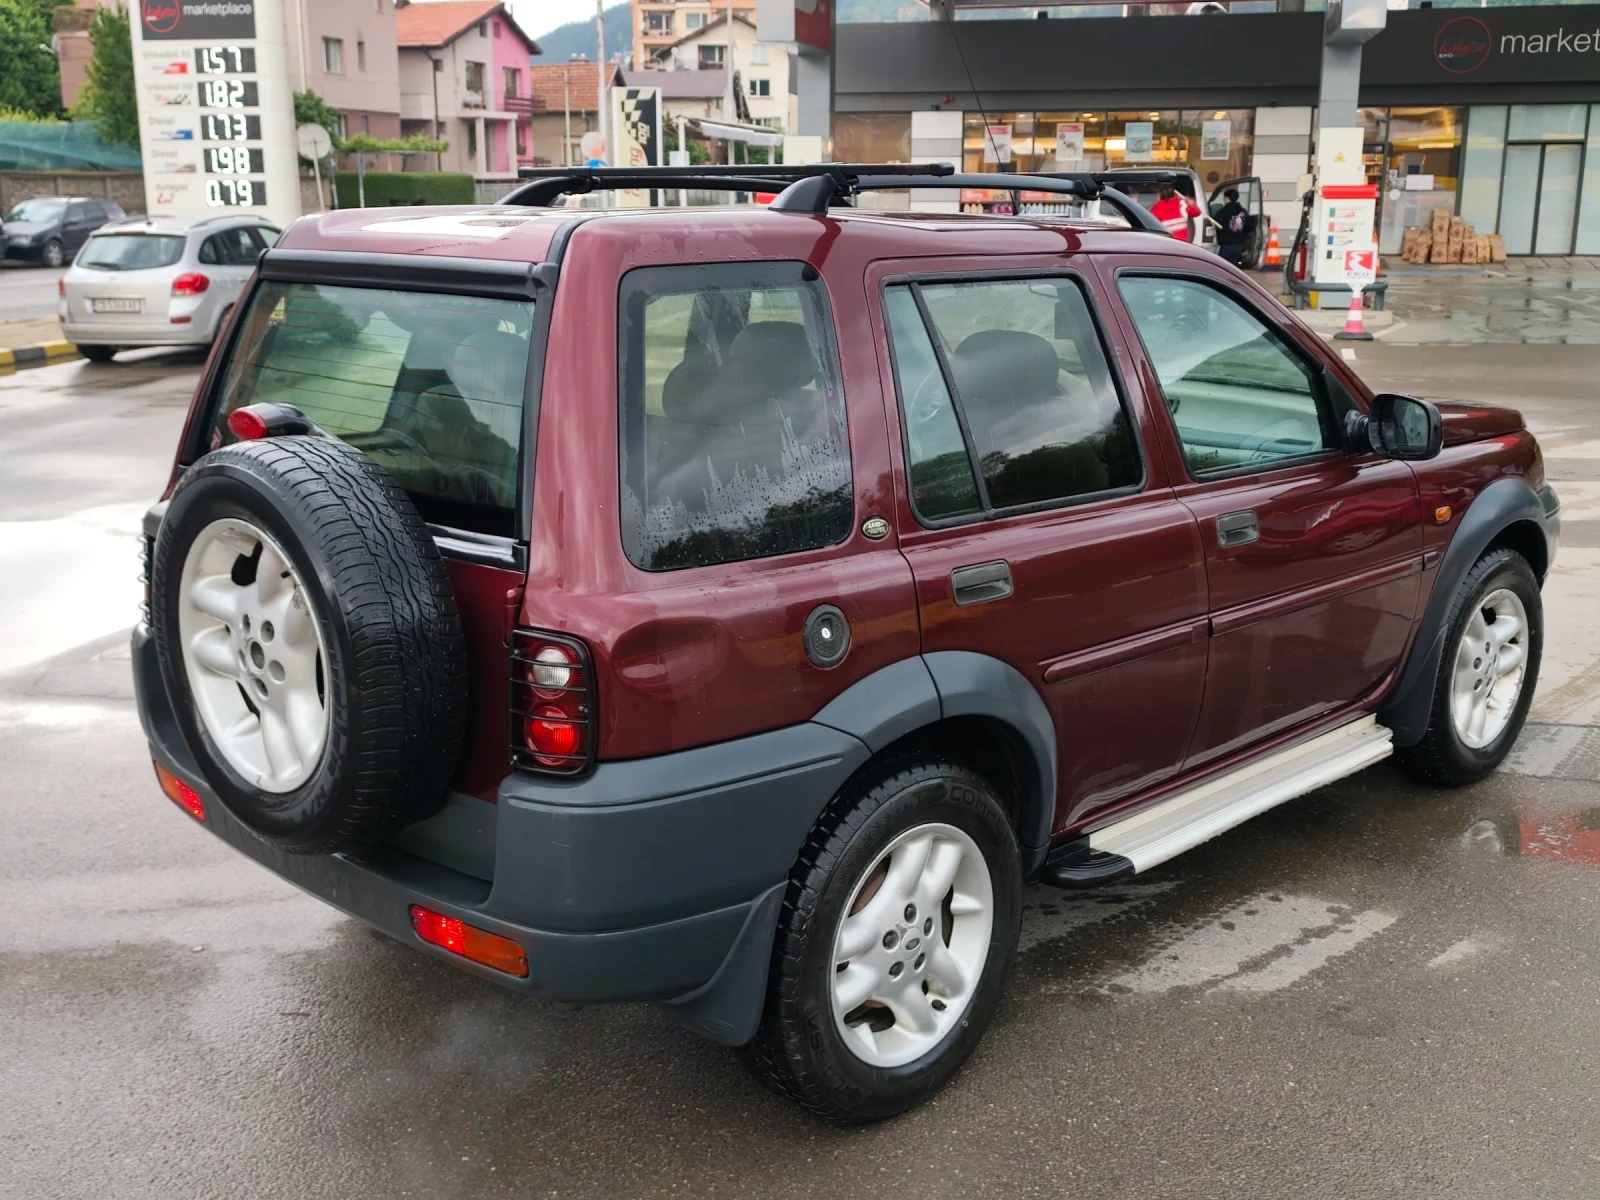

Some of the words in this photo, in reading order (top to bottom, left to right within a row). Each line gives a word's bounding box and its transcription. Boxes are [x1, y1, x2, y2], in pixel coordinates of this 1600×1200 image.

[183, 2, 253, 17] marketplace
[1500, 27, 1600, 54] market
[149, 115, 176, 125] Diesel
[151, 149, 178, 159] Diesel
